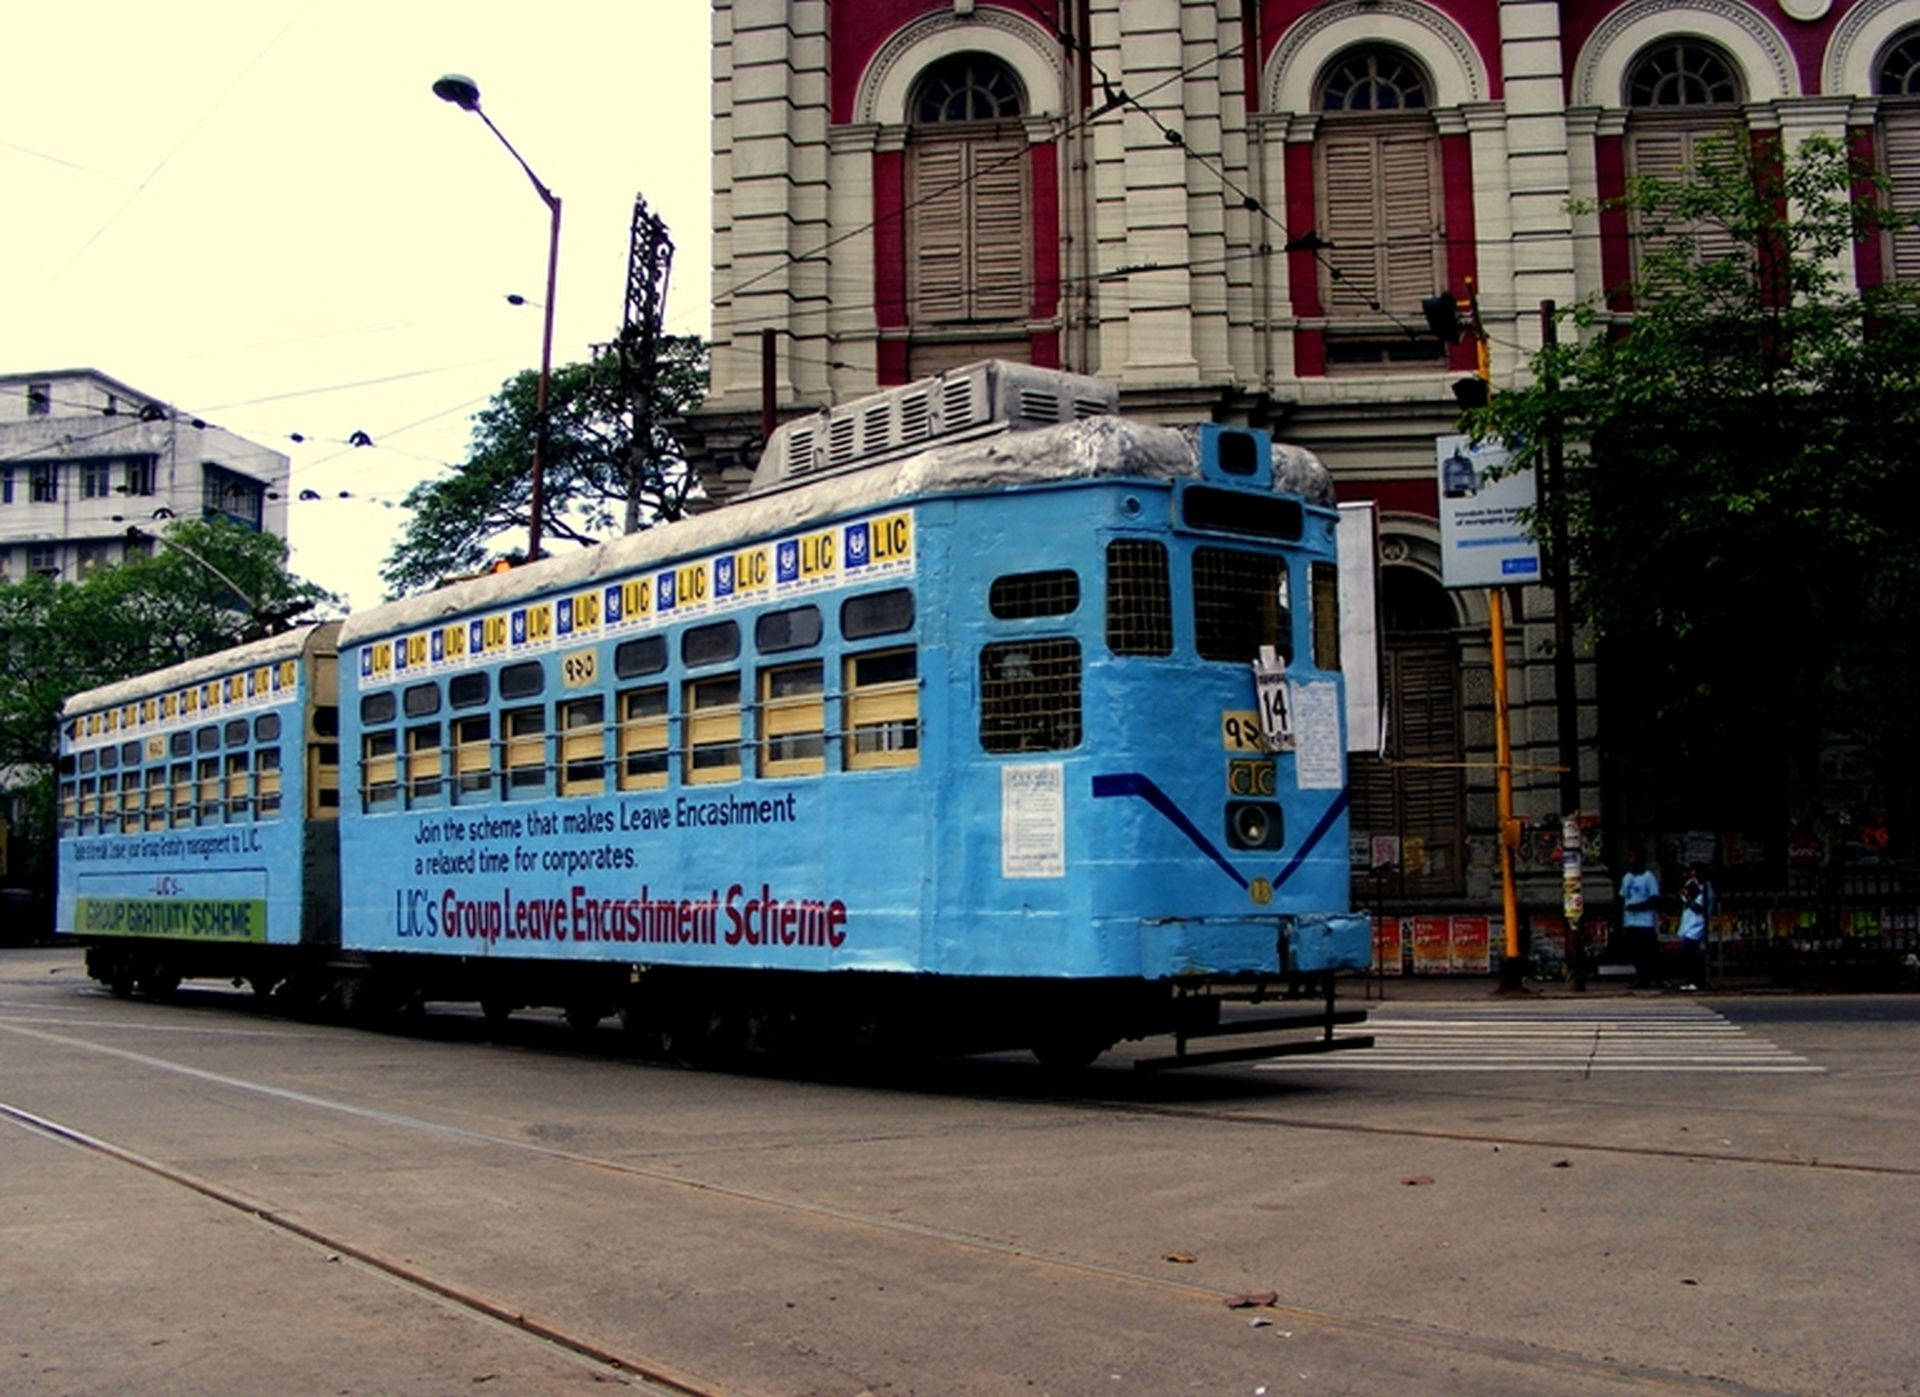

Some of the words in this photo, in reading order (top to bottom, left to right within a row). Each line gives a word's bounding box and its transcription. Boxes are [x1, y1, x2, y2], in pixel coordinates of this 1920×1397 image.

[803, 535, 833, 572] LIC
[874, 518, 907, 557] LIC
[678, 567, 704, 601] LIC
[738, 551, 766, 587] LIC
[575, 594, 598, 627] LIC
[624, 582, 650, 615] LIC
[485, 617, 506, 647] LIC
[529, 606, 549, 638] LIC
[446, 626, 465, 656] LIC
[1263, 689, 1288, 732] 14
[1230, 761, 1275, 795] CTC
[415, 819, 441, 844] Join
[443, 817, 465, 842] the
[469, 813, 522, 842] scheme
[526, 810, 559, 837] that
[563, 804, 614, 834] makes
[620, 802, 671, 831] Leave
[675, 792, 797, 828] Encashment
[415, 857, 424, 876] a
[425, 849, 476, 875] relaxed
[479, 848, 510, 873] time
[514, 845, 539, 871] for
[542, 844, 638, 876] corporates.
[86, 901, 125, 931] GROUP
[127, 901, 190, 933] GRATUITY
[192, 902, 251, 937] SCHEME
[396, 888, 438, 938] LIC's
[442, 888, 502, 945] Group
[504, 887, 567, 941] Leave
[571, 885, 719, 945] Encashment
[725, 883, 847, 948] Scheme
